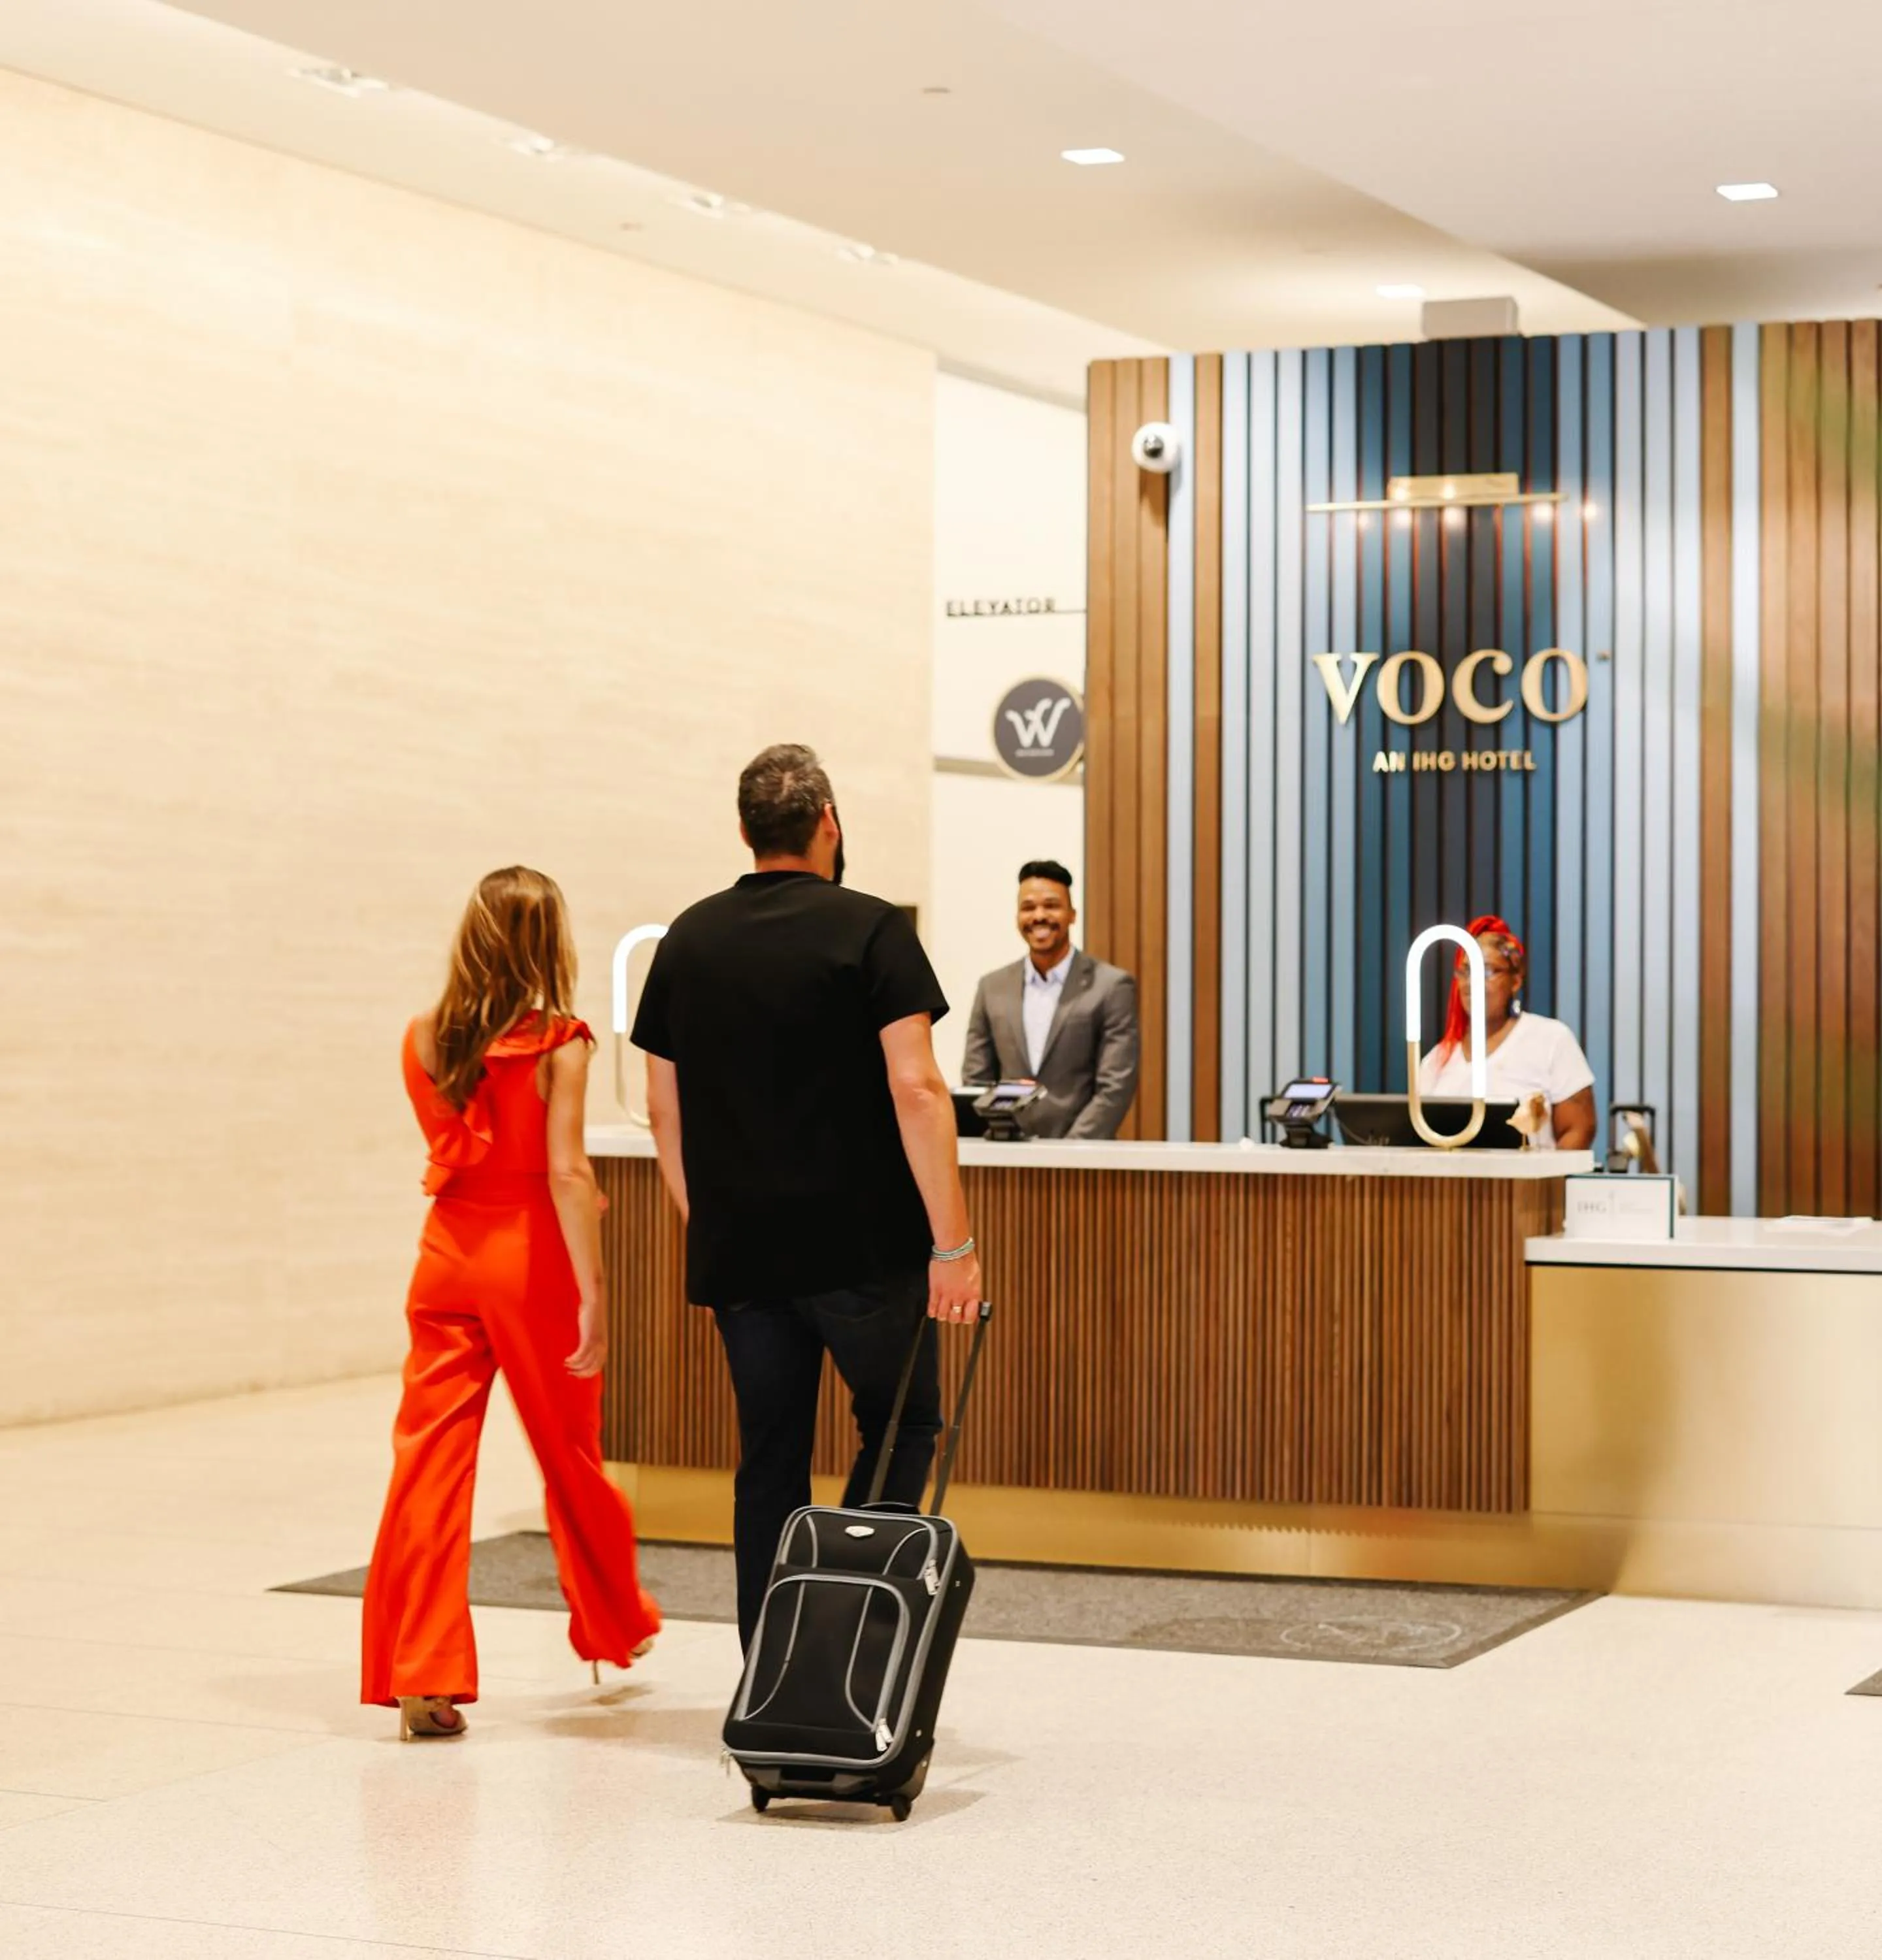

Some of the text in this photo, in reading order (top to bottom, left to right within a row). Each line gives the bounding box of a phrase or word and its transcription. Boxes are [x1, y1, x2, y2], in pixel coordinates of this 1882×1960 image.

[946, 597, 1057, 617] ELEVATOR
[1373, 750, 1537, 772] AN IHG HOTEL
